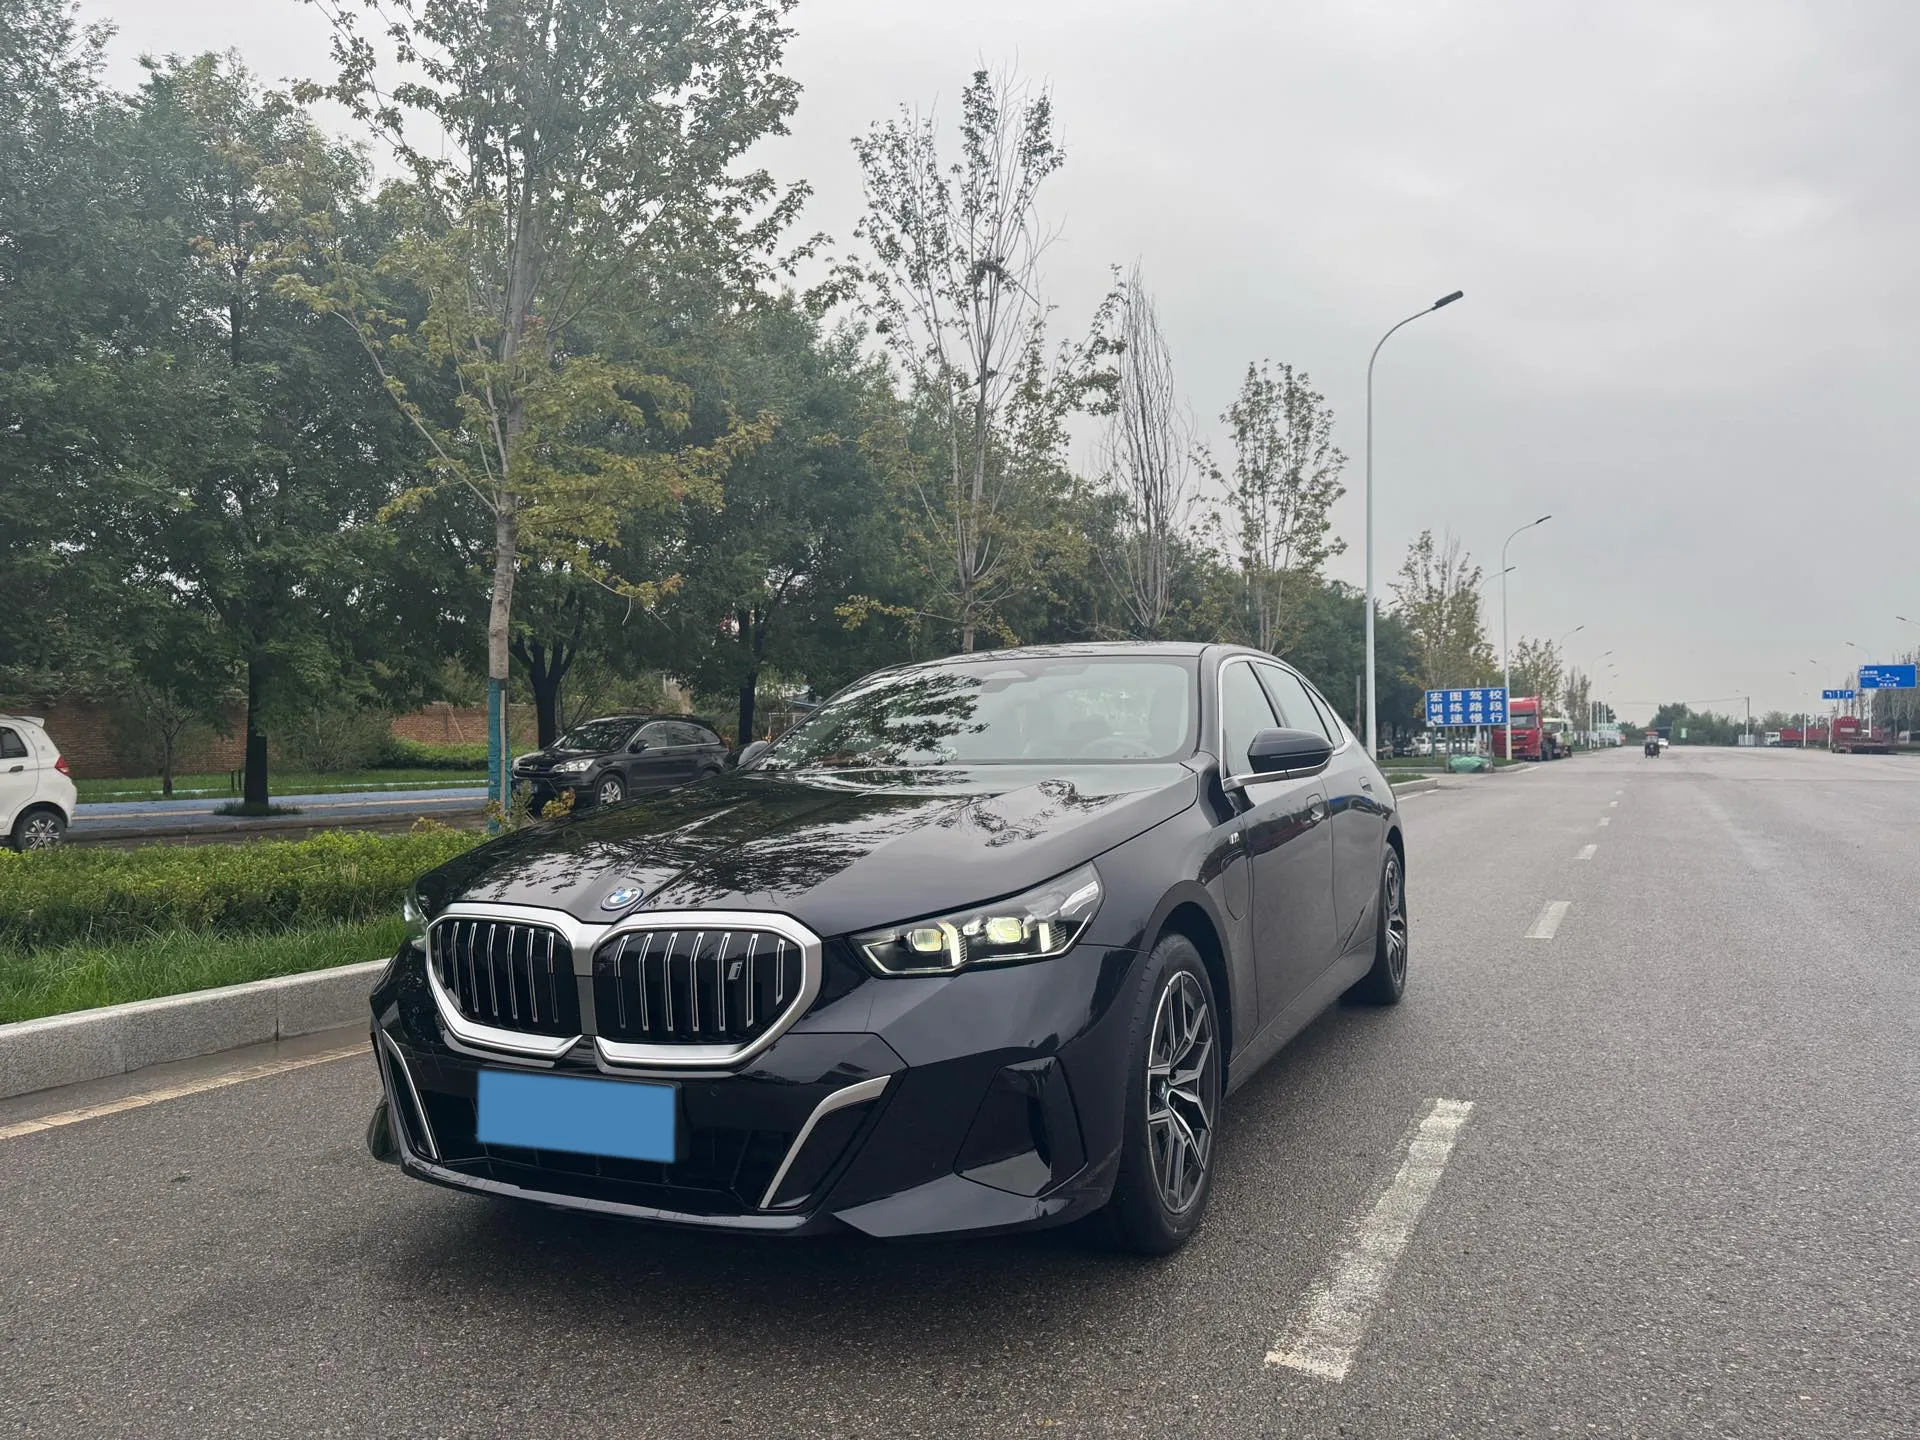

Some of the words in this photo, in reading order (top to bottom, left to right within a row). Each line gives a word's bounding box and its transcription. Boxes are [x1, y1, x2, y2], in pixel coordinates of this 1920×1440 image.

[1430, 701, 1503, 713] 训练路段
[1430, 712, 1504, 724] 减速慢行
